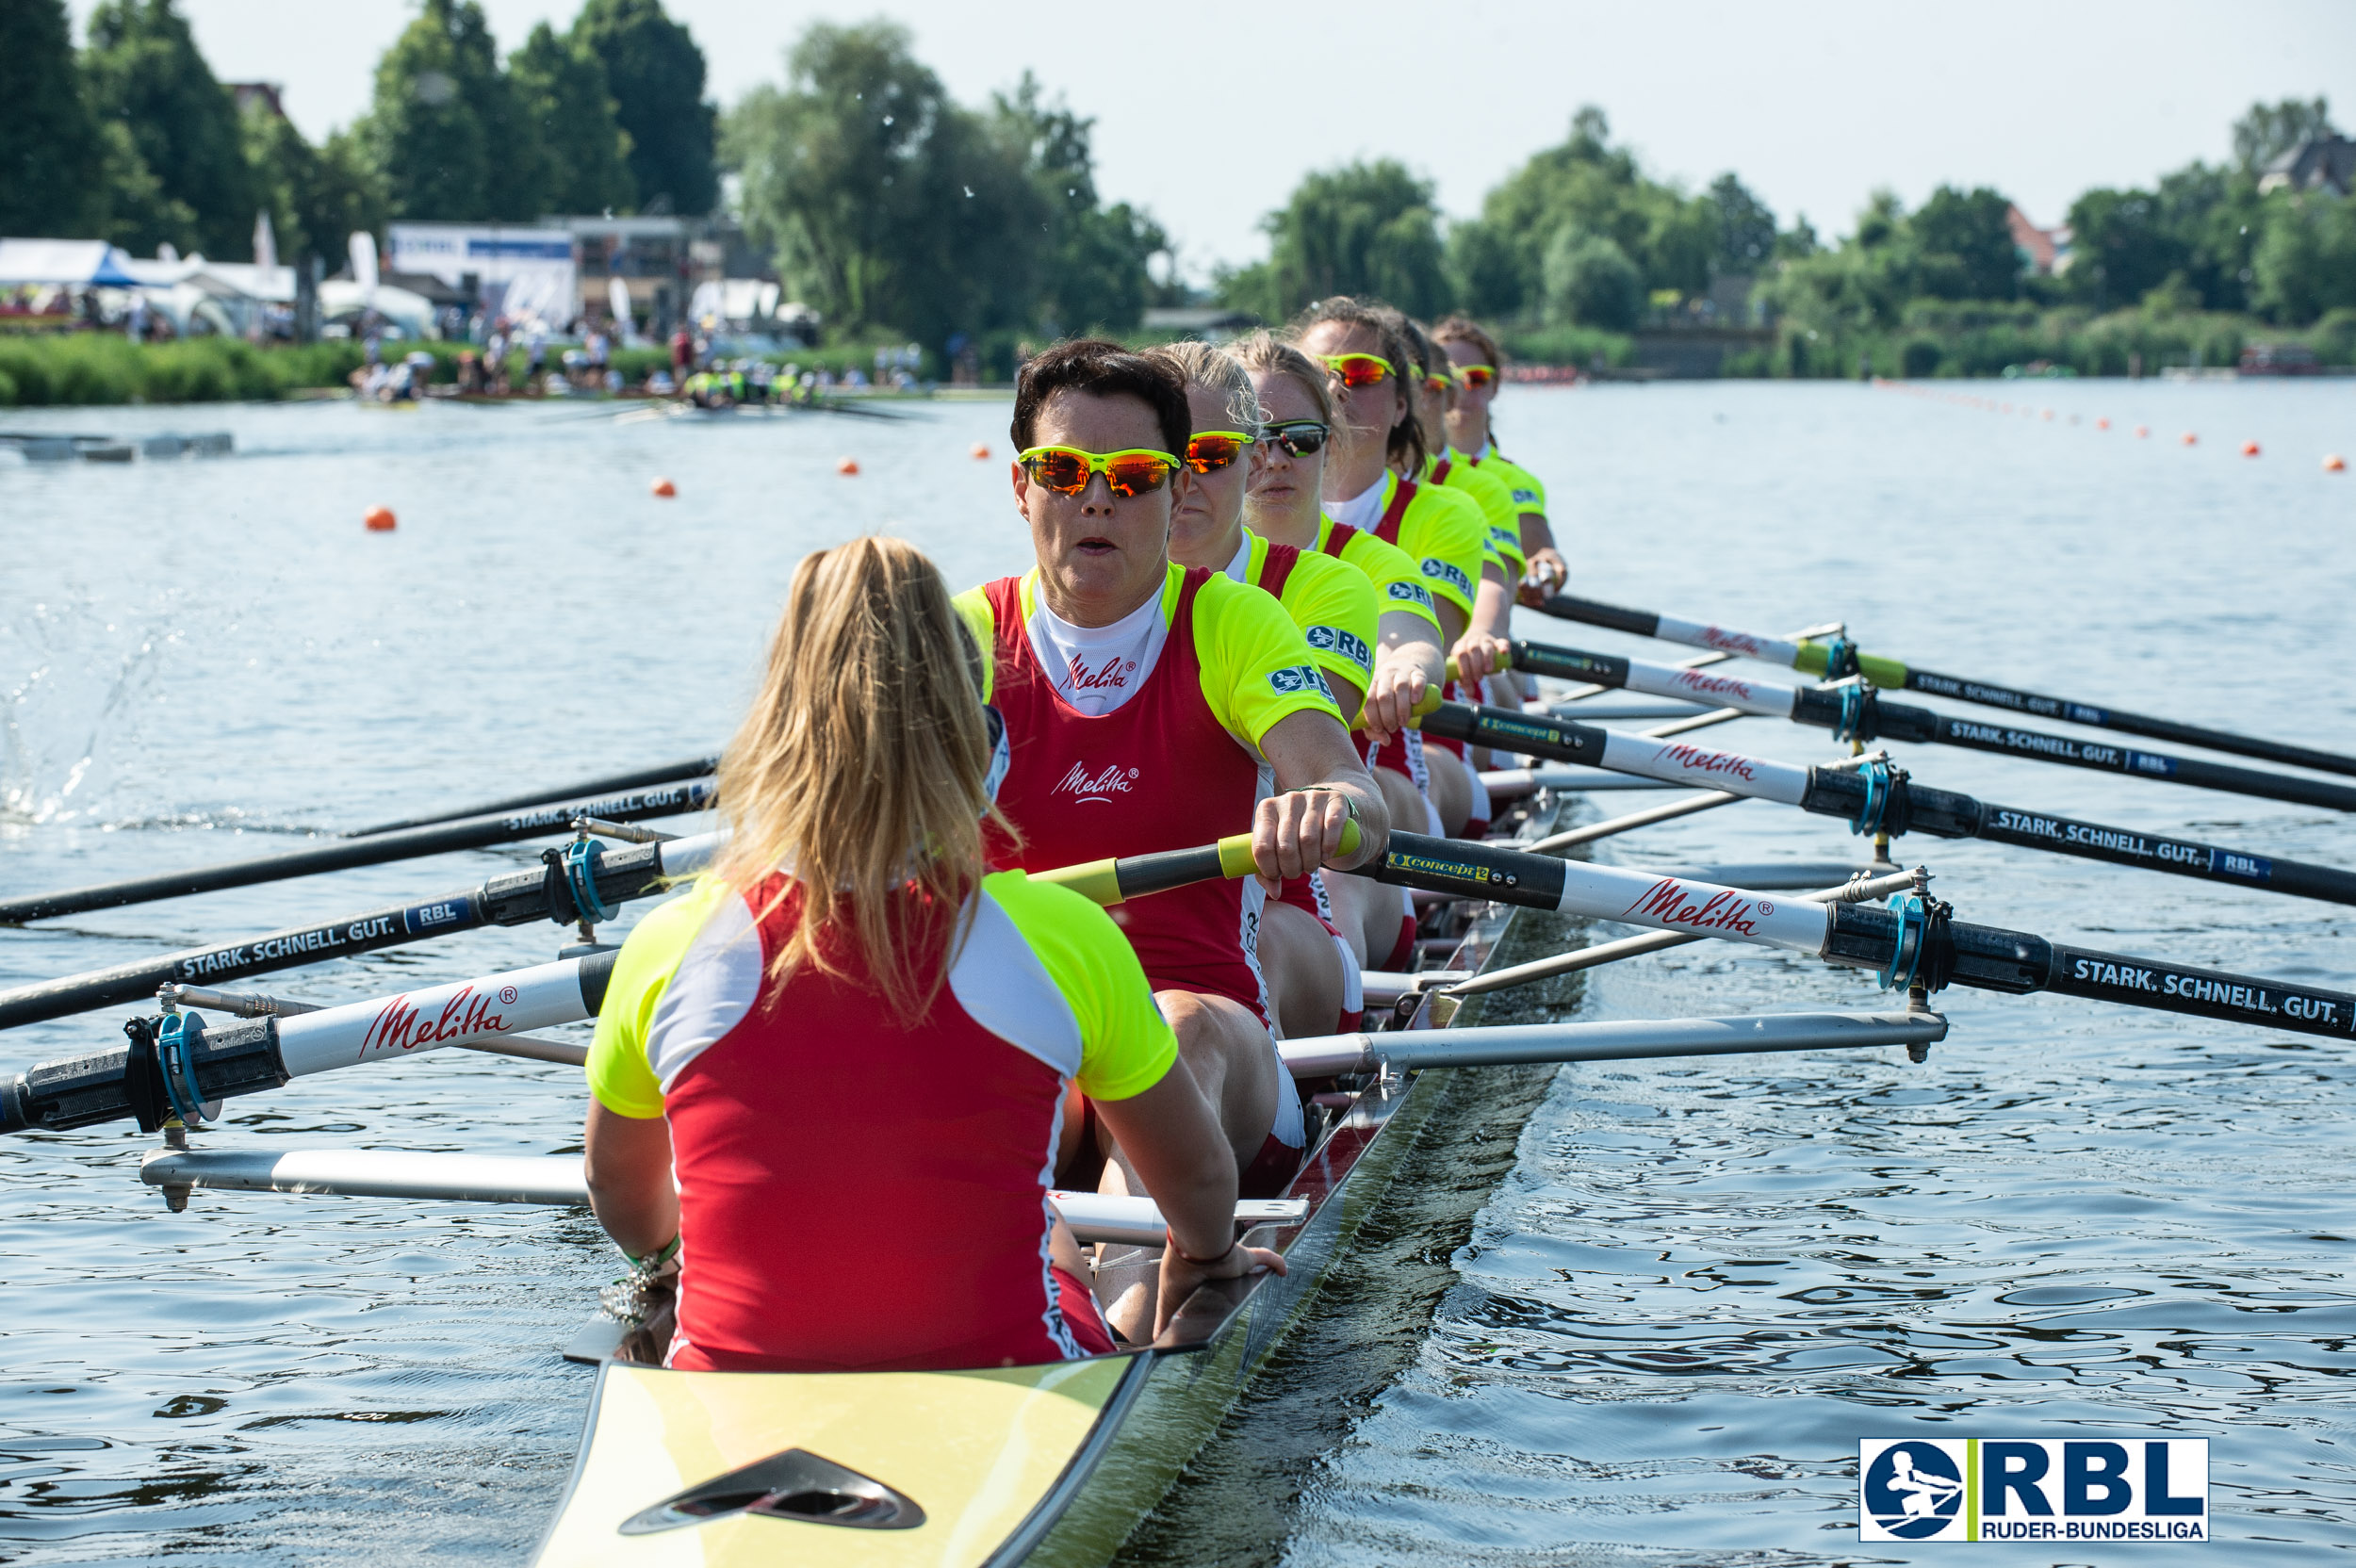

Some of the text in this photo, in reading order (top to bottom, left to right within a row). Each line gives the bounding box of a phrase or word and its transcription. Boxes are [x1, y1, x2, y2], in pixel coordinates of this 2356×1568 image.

[1652, 743, 1758, 781] Melitta
[1951, 722, 2119, 764] STARK. SCHNELL. GUT.
[1050, 760, 1133, 795] Melitta
[643, 789, 682, 809] GUT.
[1999, 811, 2200, 866] STARK. SCHNELL. GUT.
[1411, 857, 1475, 876] concept
[2224, 855, 2259, 874] RBL
[419, 903, 456, 923] RBL
[1622, 877, 1761, 936] Melitta
[182, 916, 396, 976] STARK. SCHNELL. GUT.
[2074, 959, 2338, 1024] STARK. SCHNELL. GUT.
[359, 985, 515, 1059] Melitta
